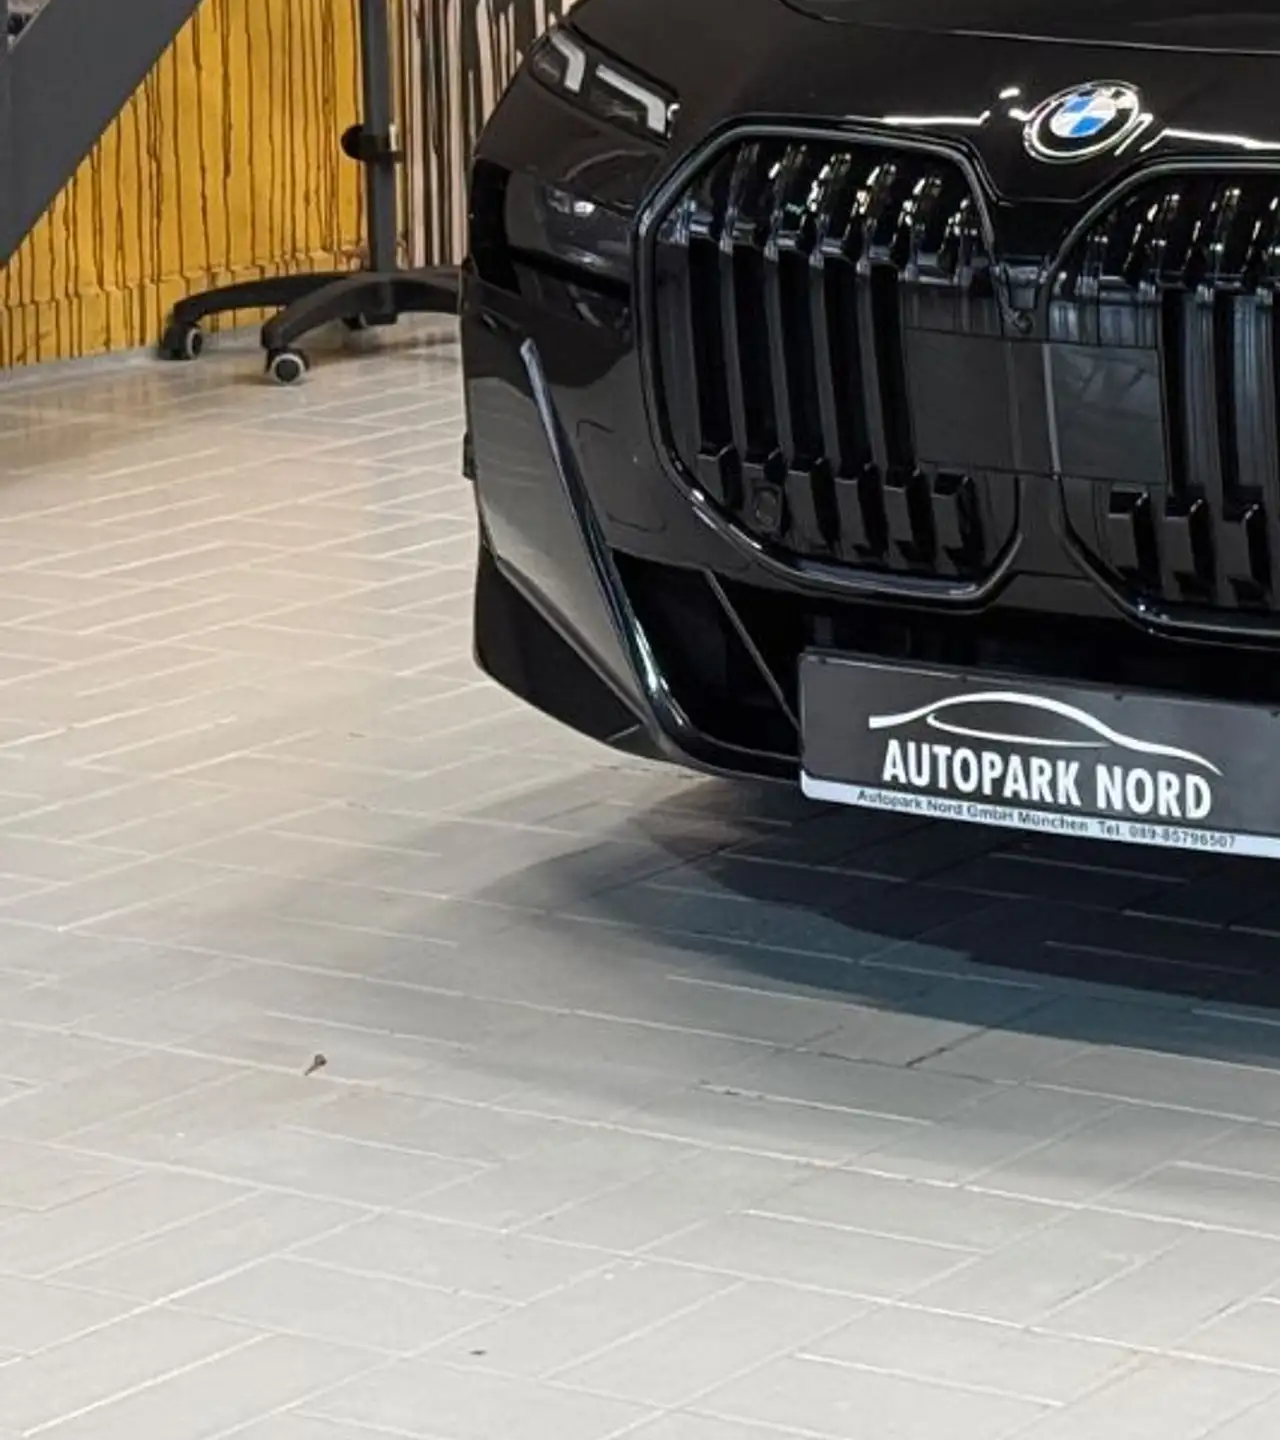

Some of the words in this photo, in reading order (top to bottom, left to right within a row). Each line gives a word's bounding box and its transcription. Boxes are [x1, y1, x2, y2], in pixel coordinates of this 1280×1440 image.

[882, 739, 1081, 807] AUTOPARK
[1096, 763, 1212, 821] NORD
[857, 789, 925, 810] Autopark
[927, 798, 963, 816] Nord
[967, 803, 1014, 822] GmbH
[1017, 810, 1089, 833] München
[1098, 820, 1124, 837] Tel.
